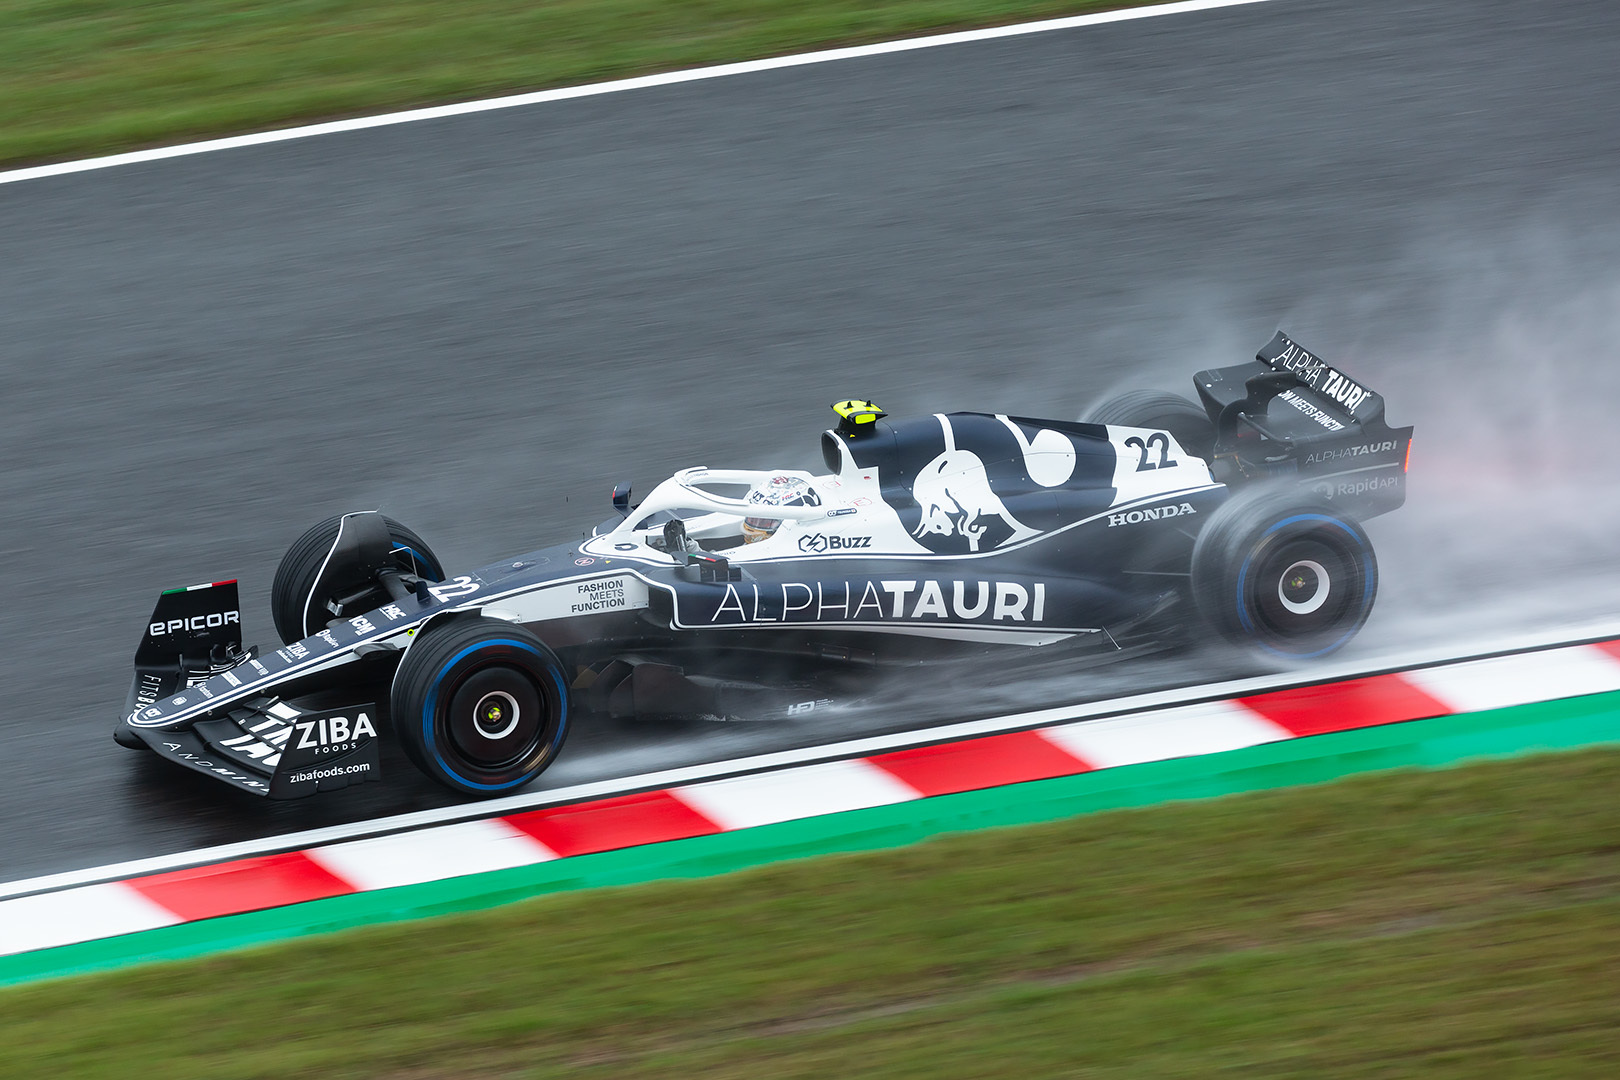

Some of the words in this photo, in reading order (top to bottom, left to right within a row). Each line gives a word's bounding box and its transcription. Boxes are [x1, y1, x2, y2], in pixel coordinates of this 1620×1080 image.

[1276, 344, 1323, 387] ALPHA
[1322, 370, 1367, 412] TAURI
[1288, 396, 1317, 415] MEETS
[1125, 432, 1178, 473] 22
[1305, 440, 1398, 465] ALPHATAURI
[1107, 502, 1196, 528] HONDA
[427, 576, 480, 603] 22
[577, 579, 624, 594] FASHION
[588, 588, 625, 602] MEETS
[570, 597, 625, 615] FUNCTION
[711, 580, 1046, 622] ALPHATAURI
[348, 615, 377, 635] ICM
[286, 641, 310, 659] ZIBA
[295, 712, 378, 750] ZIBA
[314, 742, 358, 756] FOODS
[289, 762, 371, 784] zibafoods.com
